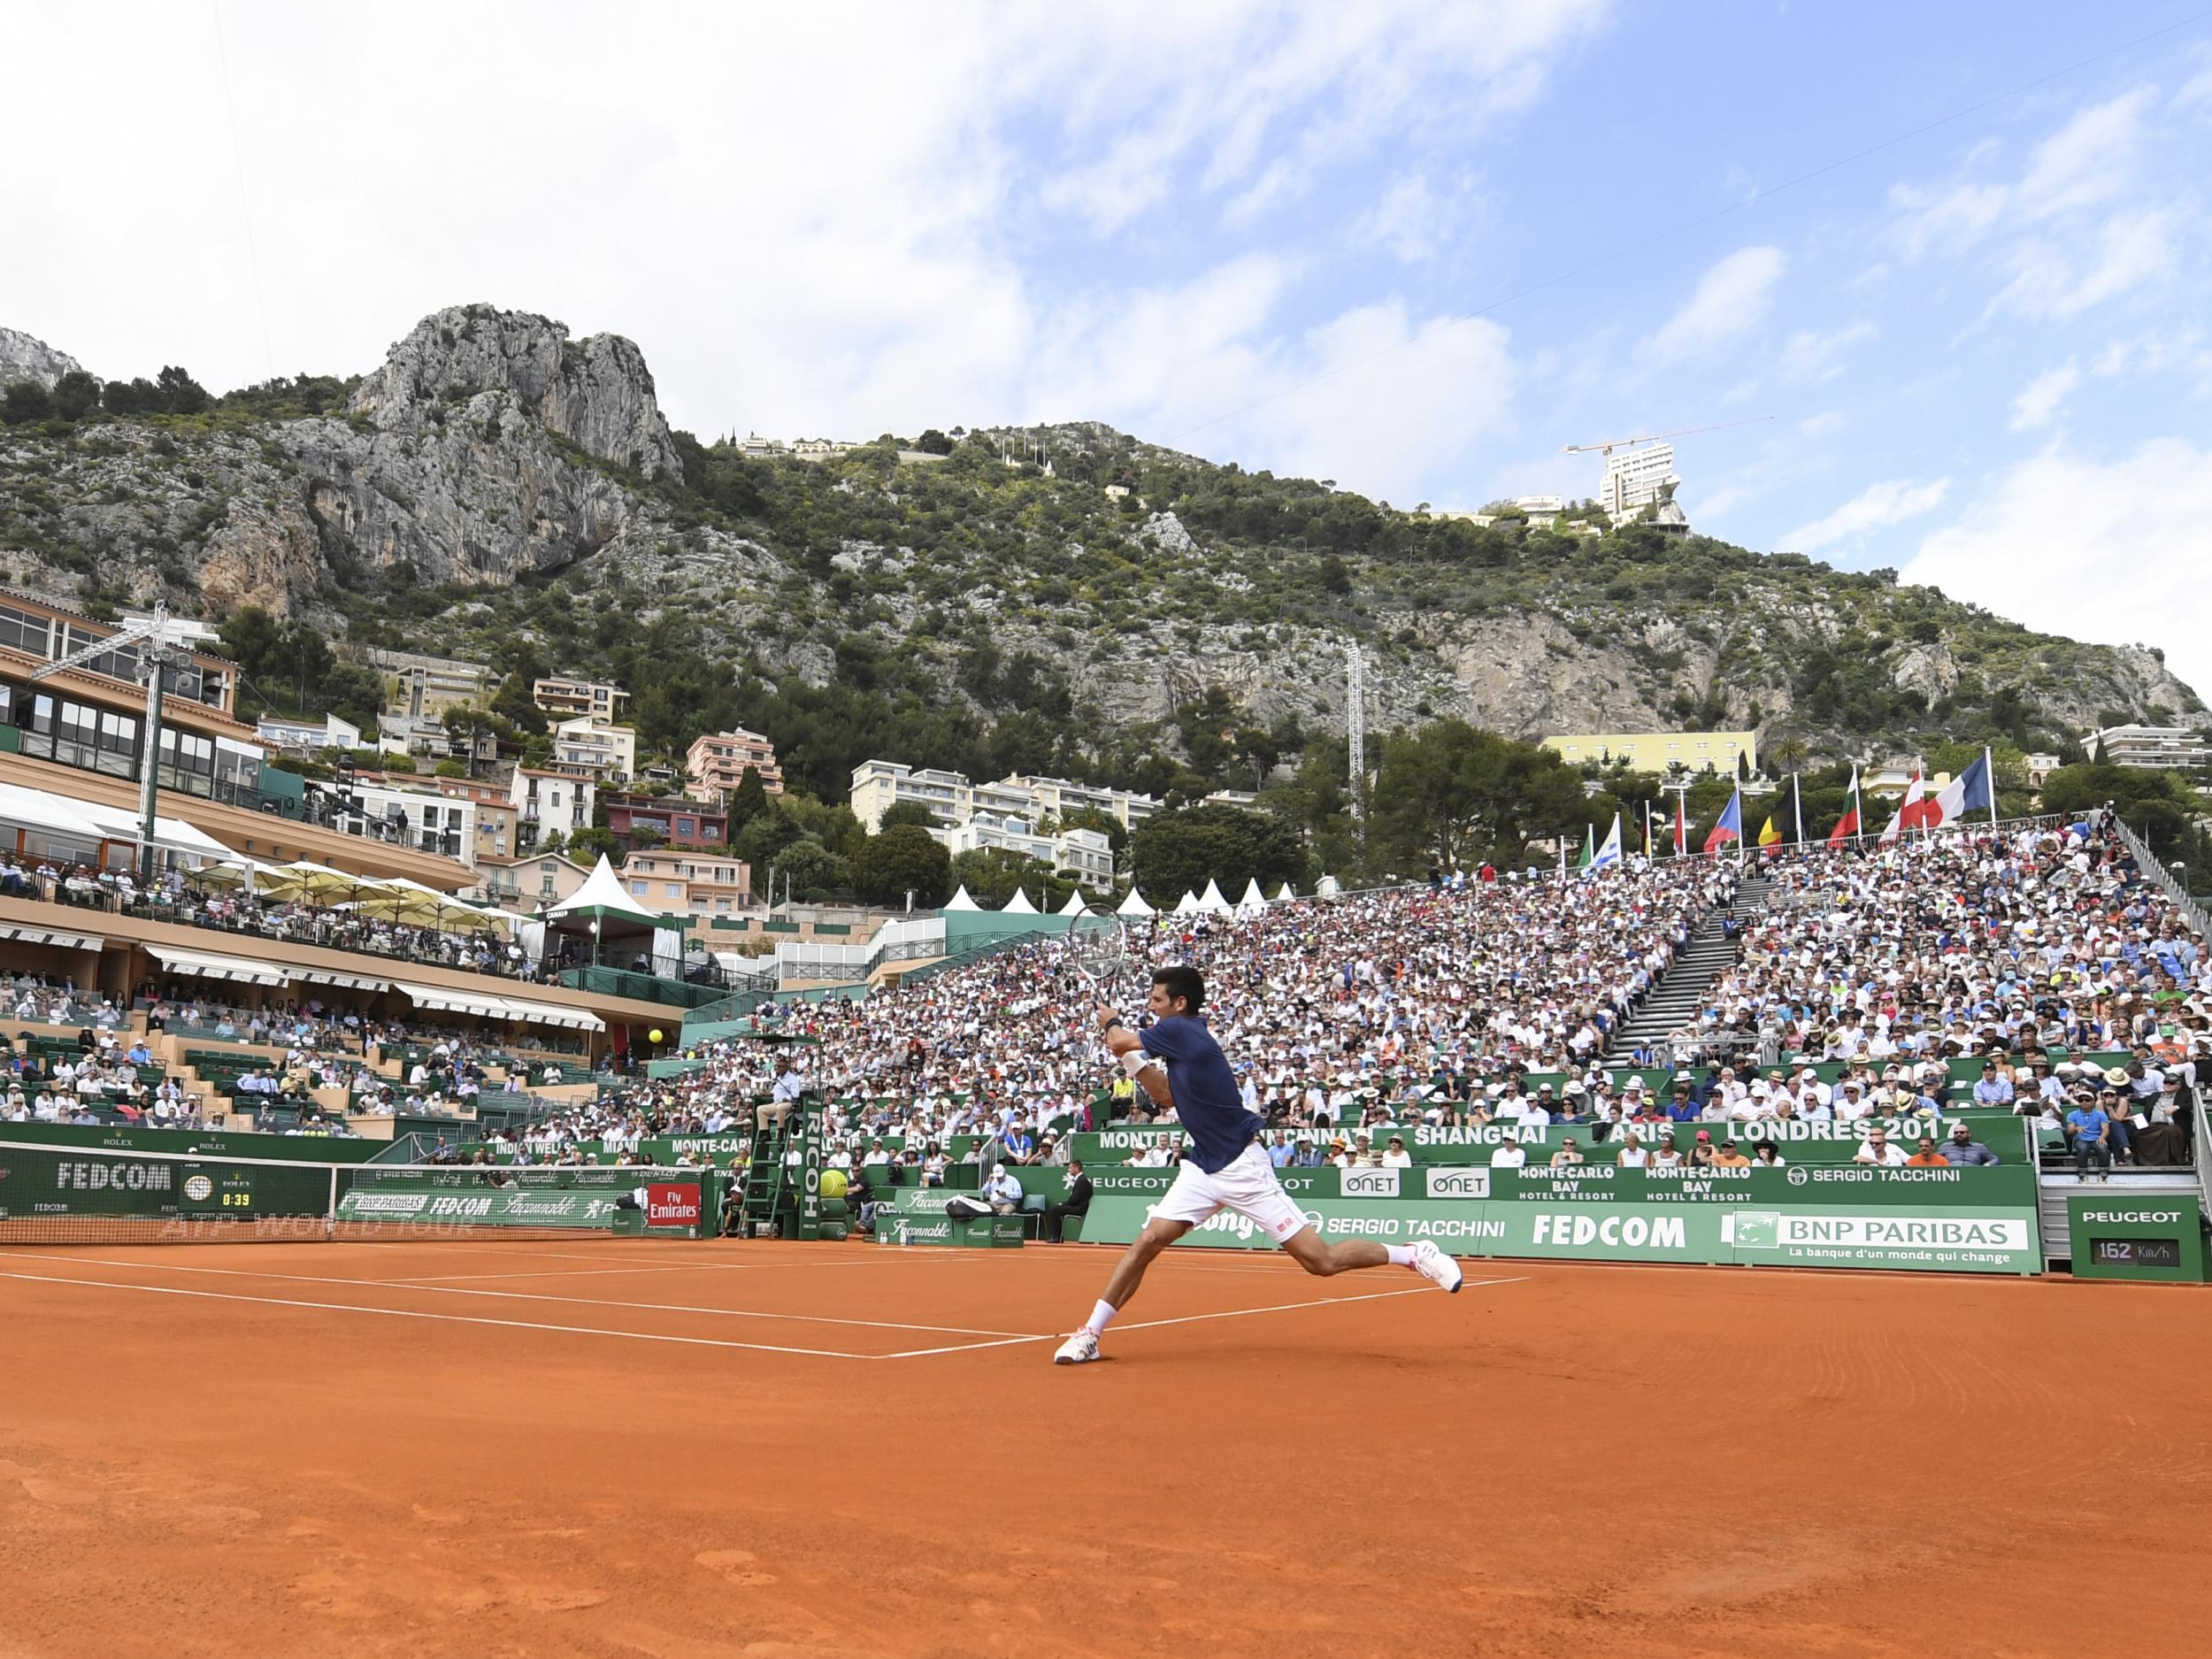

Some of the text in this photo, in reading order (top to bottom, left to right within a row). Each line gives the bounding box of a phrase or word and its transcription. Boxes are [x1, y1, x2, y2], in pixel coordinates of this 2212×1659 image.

[1414, 1125, 1547, 1145] SHANGHAI
[1609, 1123, 1675, 1142] ARIS
[1727, 1118, 1962, 1141] LONDRES 2017
[104, 1138, 133, 1147] ROLEX
[603, 1141, 639, 1154] MIAMI
[672, 1139, 752, 1153] MONTE-CAR
[1100, 1132, 1196, 1148] MONTEA
[804, 1111, 822, 1217] RICOH
[57, 1162, 172, 1191] FEDCOM
[1517, 1167, 1615, 1179] MONTE-CARLO
[1646, 1166, 1751, 1179] MONTE-CARLO
[1813, 1170, 1961, 1182] SERGIO TACCHINI
[1552, 1181, 1579, 1193] BAY
[1683, 1181, 1713, 1193] BAY
[222, 1194, 250, 1206] 0:39
[667, 1191, 681, 1204] Fly
[430, 1197, 493, 1217] FEDCOM
[650, 1202, 697, 1219] Emirates
[2082, 1211, 2182, 1223] PEUGEOT
[1327, 1217, 1505, 1238] SERGIO TACCHINI
[1532, 1215, 1686, 1248] FEDCOM
[1790, 1220, 2008, 1245] BNP PARIBAS
[1788, 1247, 2010, 1264] La banque d'un monde qui change
[2099, 1242, 2170, 1259] 162 Km/h
